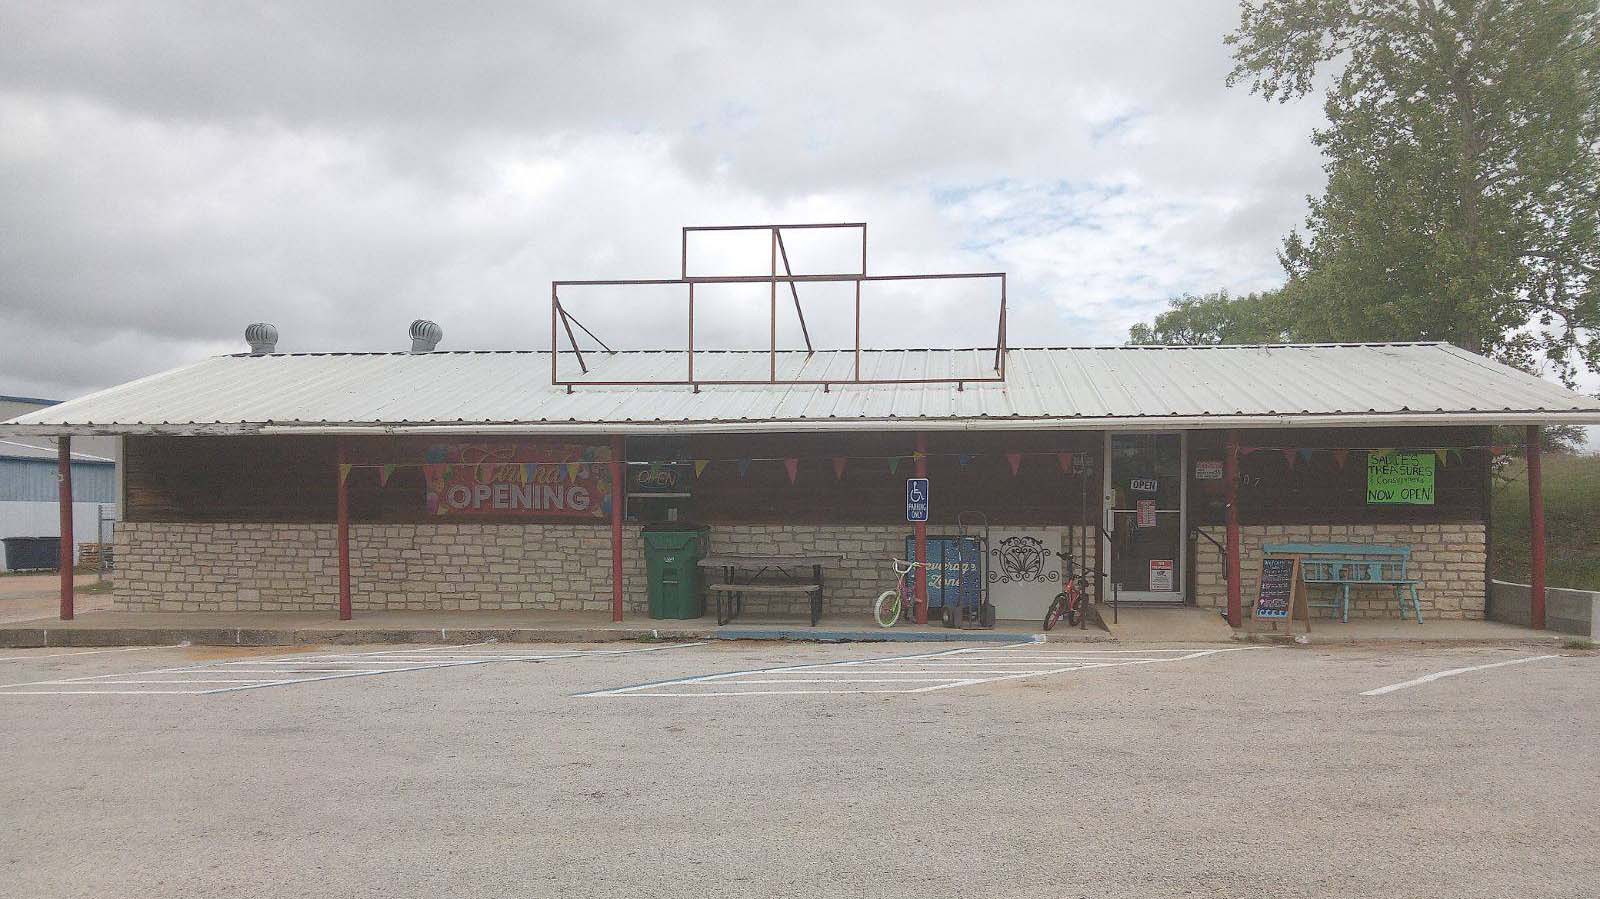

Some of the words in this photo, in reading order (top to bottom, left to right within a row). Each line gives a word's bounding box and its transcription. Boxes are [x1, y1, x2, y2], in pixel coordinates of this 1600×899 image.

[1368, 465, 1433, 476] TREASURES
[447, 483, 591, 511] OPENING
[1368, 489, 1394, 501] NOW
[925, 562, 977, 574] everage
